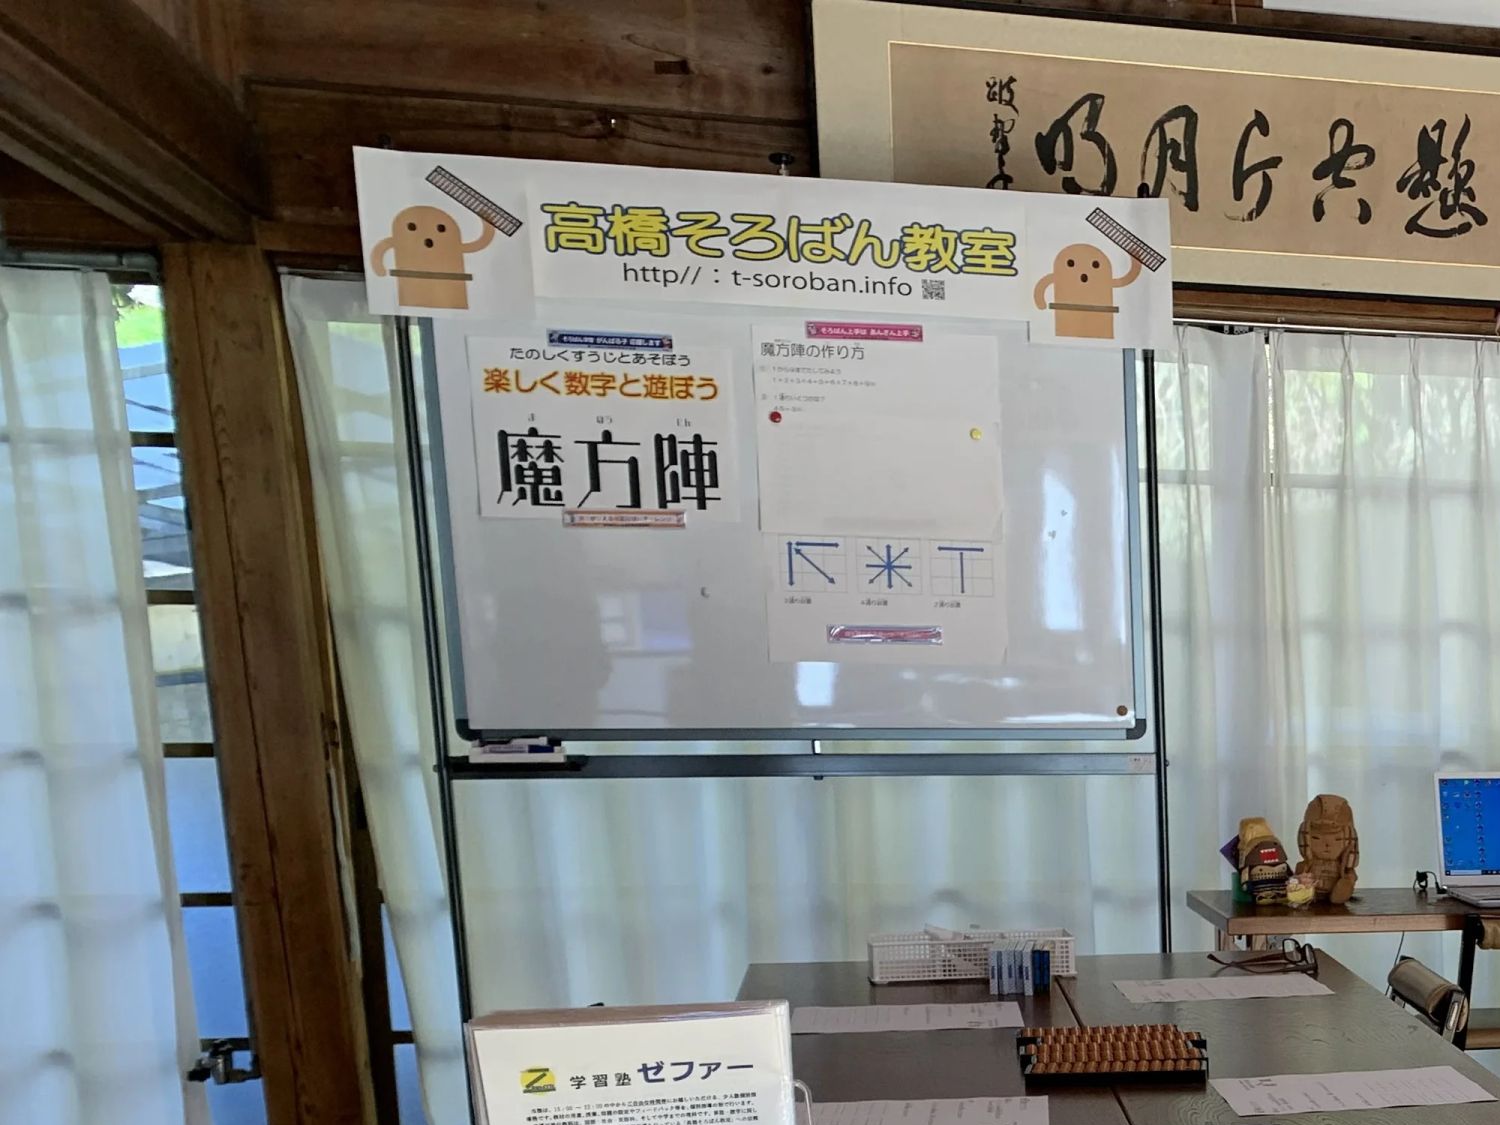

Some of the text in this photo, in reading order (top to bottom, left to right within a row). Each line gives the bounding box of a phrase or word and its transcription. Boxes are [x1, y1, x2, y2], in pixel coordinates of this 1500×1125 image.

[542, 201, 1019, 277] 高橋そろばん教室
[731, 269, 913, 297] t-soroban.info
[509, 347, 692, 367] たのしくすうじとあそぼう
[760, 342, 866, 362] 魔方陣の作り方
[483, 367, 719, 401] 楽しく数字と遊ぼう
[497, 425, 722, 511] 魔方陣
[569, 1060, 755, 1090] 学習塾 ゼファー
